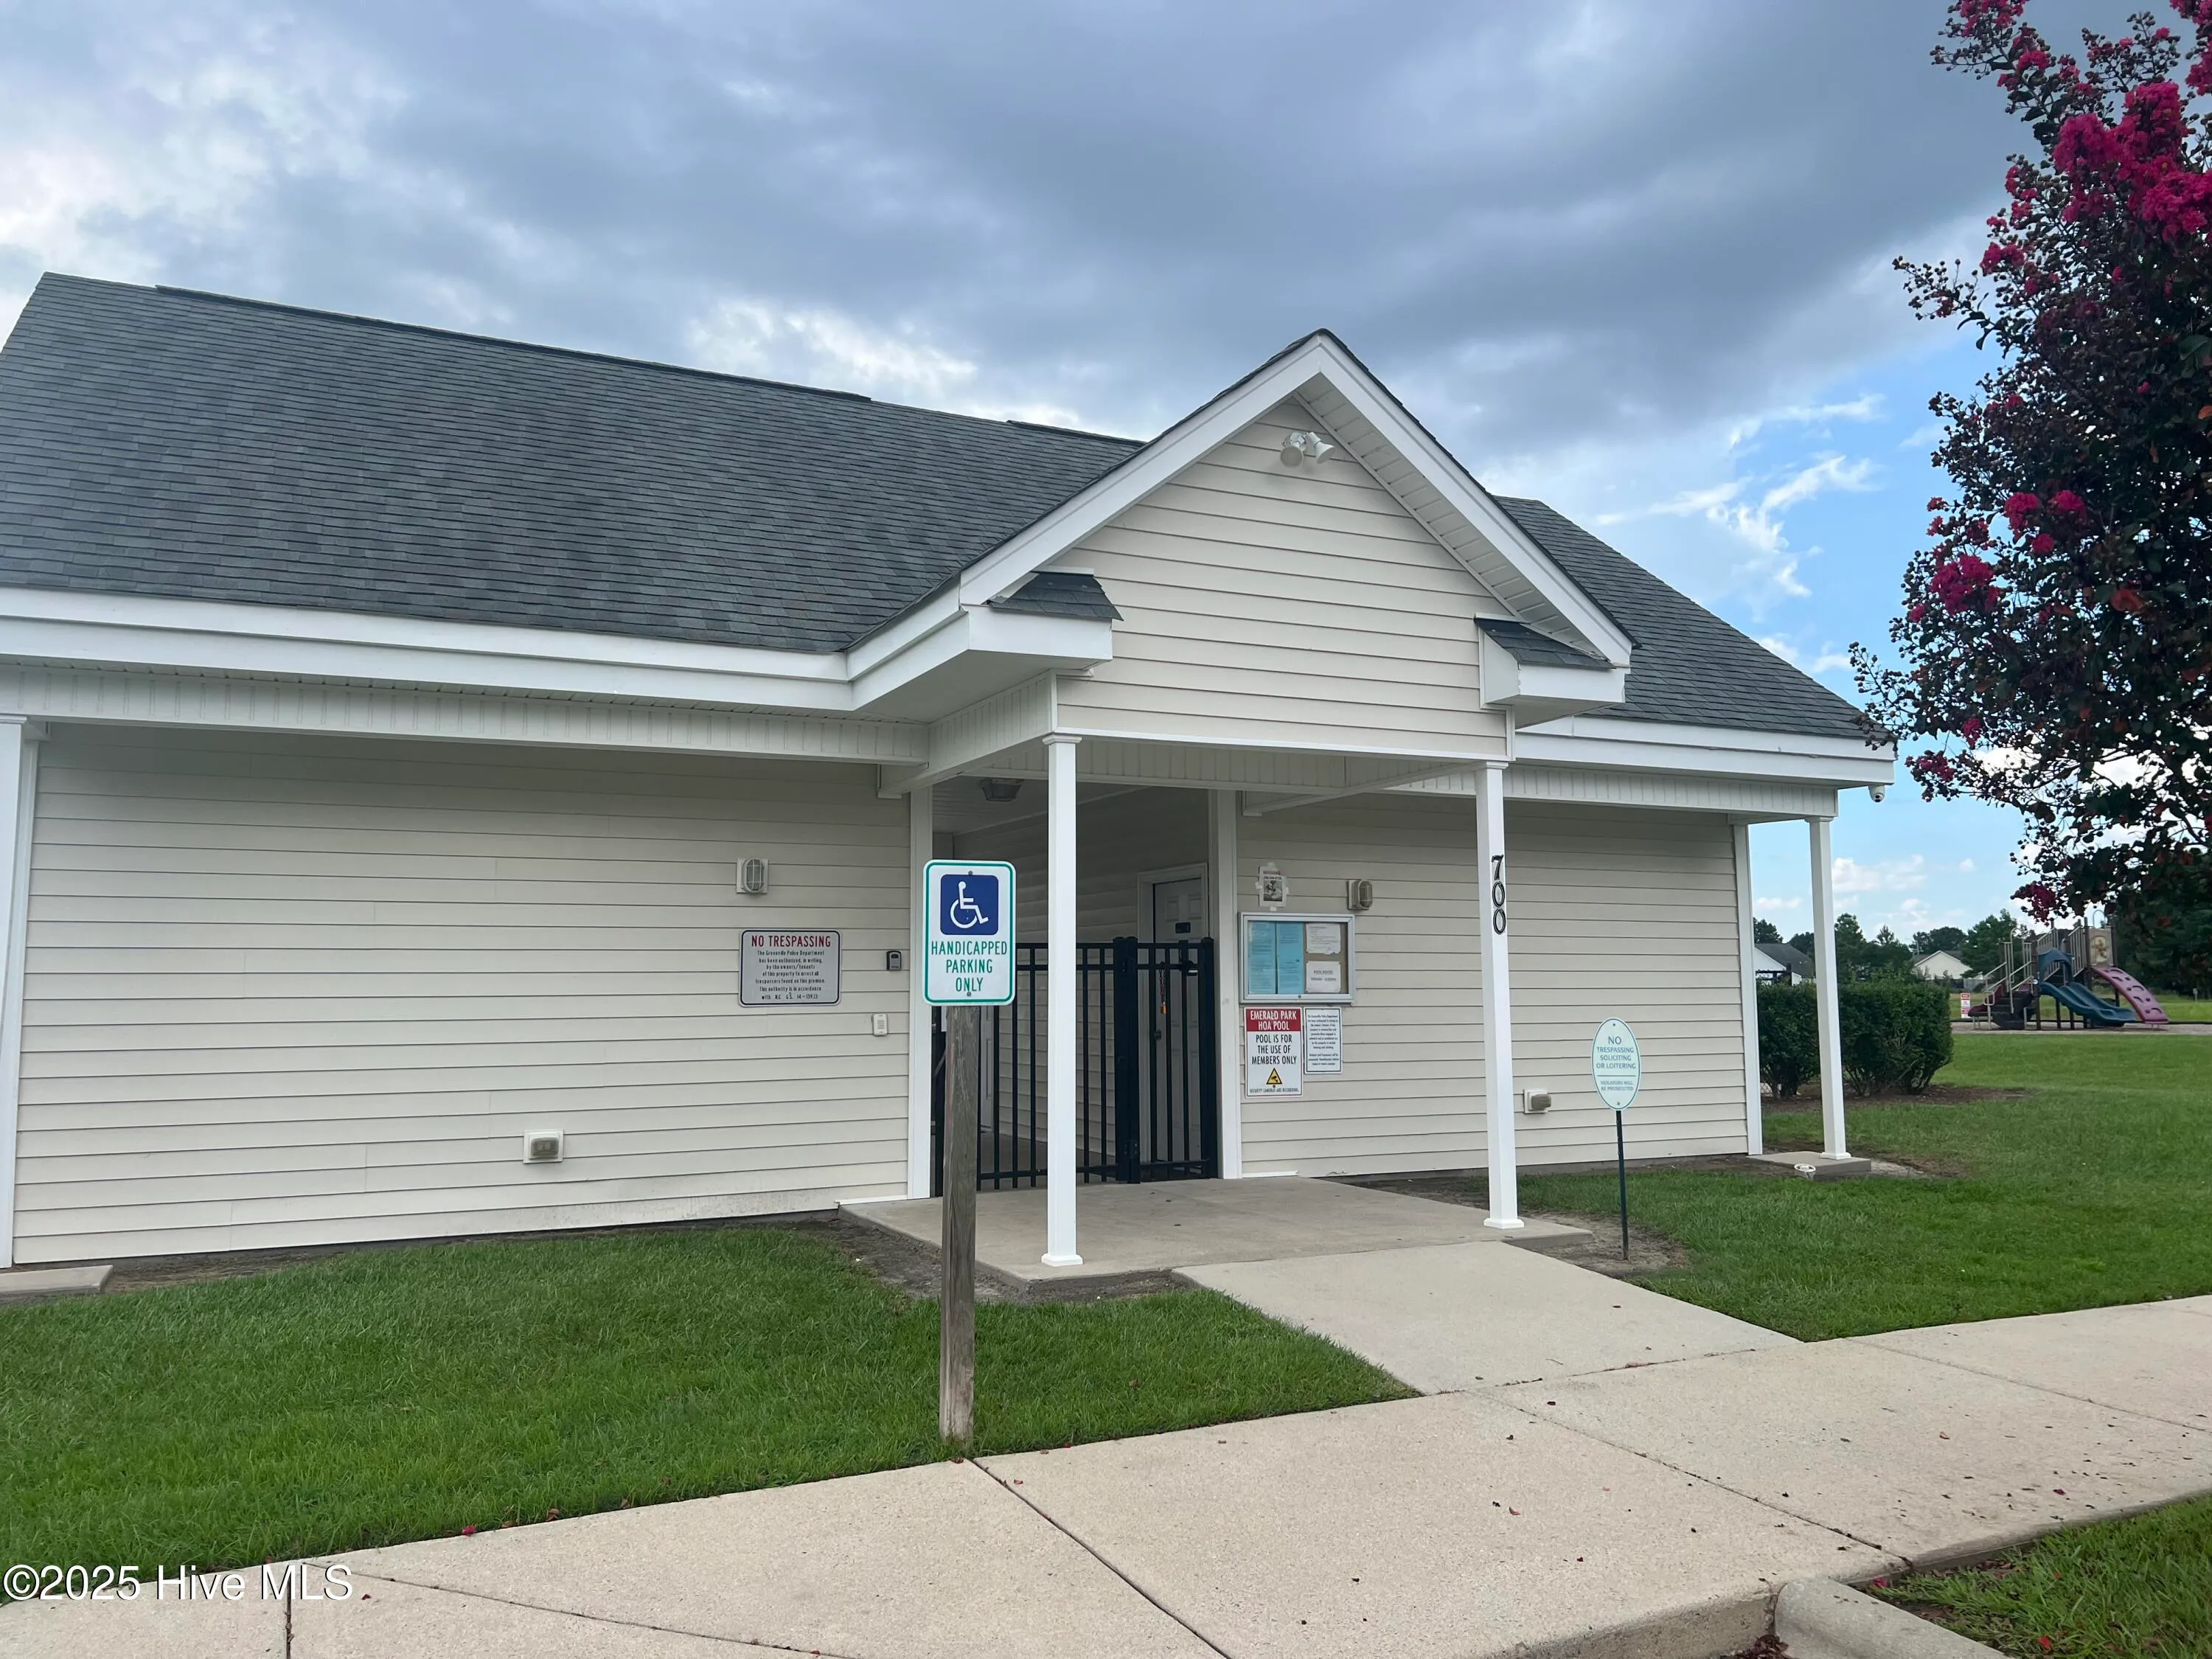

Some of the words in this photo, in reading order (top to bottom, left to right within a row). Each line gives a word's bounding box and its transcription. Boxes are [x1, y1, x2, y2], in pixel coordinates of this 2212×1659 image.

[1491, 854, 1506, 935] 700
[751, 935, 765, 947] NO
[768, 935, 831, 947] TRESPASSING
[931, 940, 1007, 956] HANDICAPPED
[946, 959, 993, 974] PARKING
[956, 977, 984, 992] ONLY
[1250, 1010, 1279, 1020] EMERALD
[1280, 1010, 1297, 1020] PARK
[1258, 1020, 1272, 1031] HOA
[1273, 1020, 1290, 1031] POOL
[1256, 1034, 1271, 1043] POOL
[1273, 1034, 1279, 1043] IS
[1281, 1034, 1293, 1043] FOR
[1607, 1036, 1622, 1045] NO
[1257, 1045, 1269, 1054] THE
[1270, 1045, 1281, 1054] USE
[1283, 1045, 1291, 1054] OF
[1251, 1055, 1280, 1065] MEMBERS
[1281, 1055, 1297, 1065] ONLY
